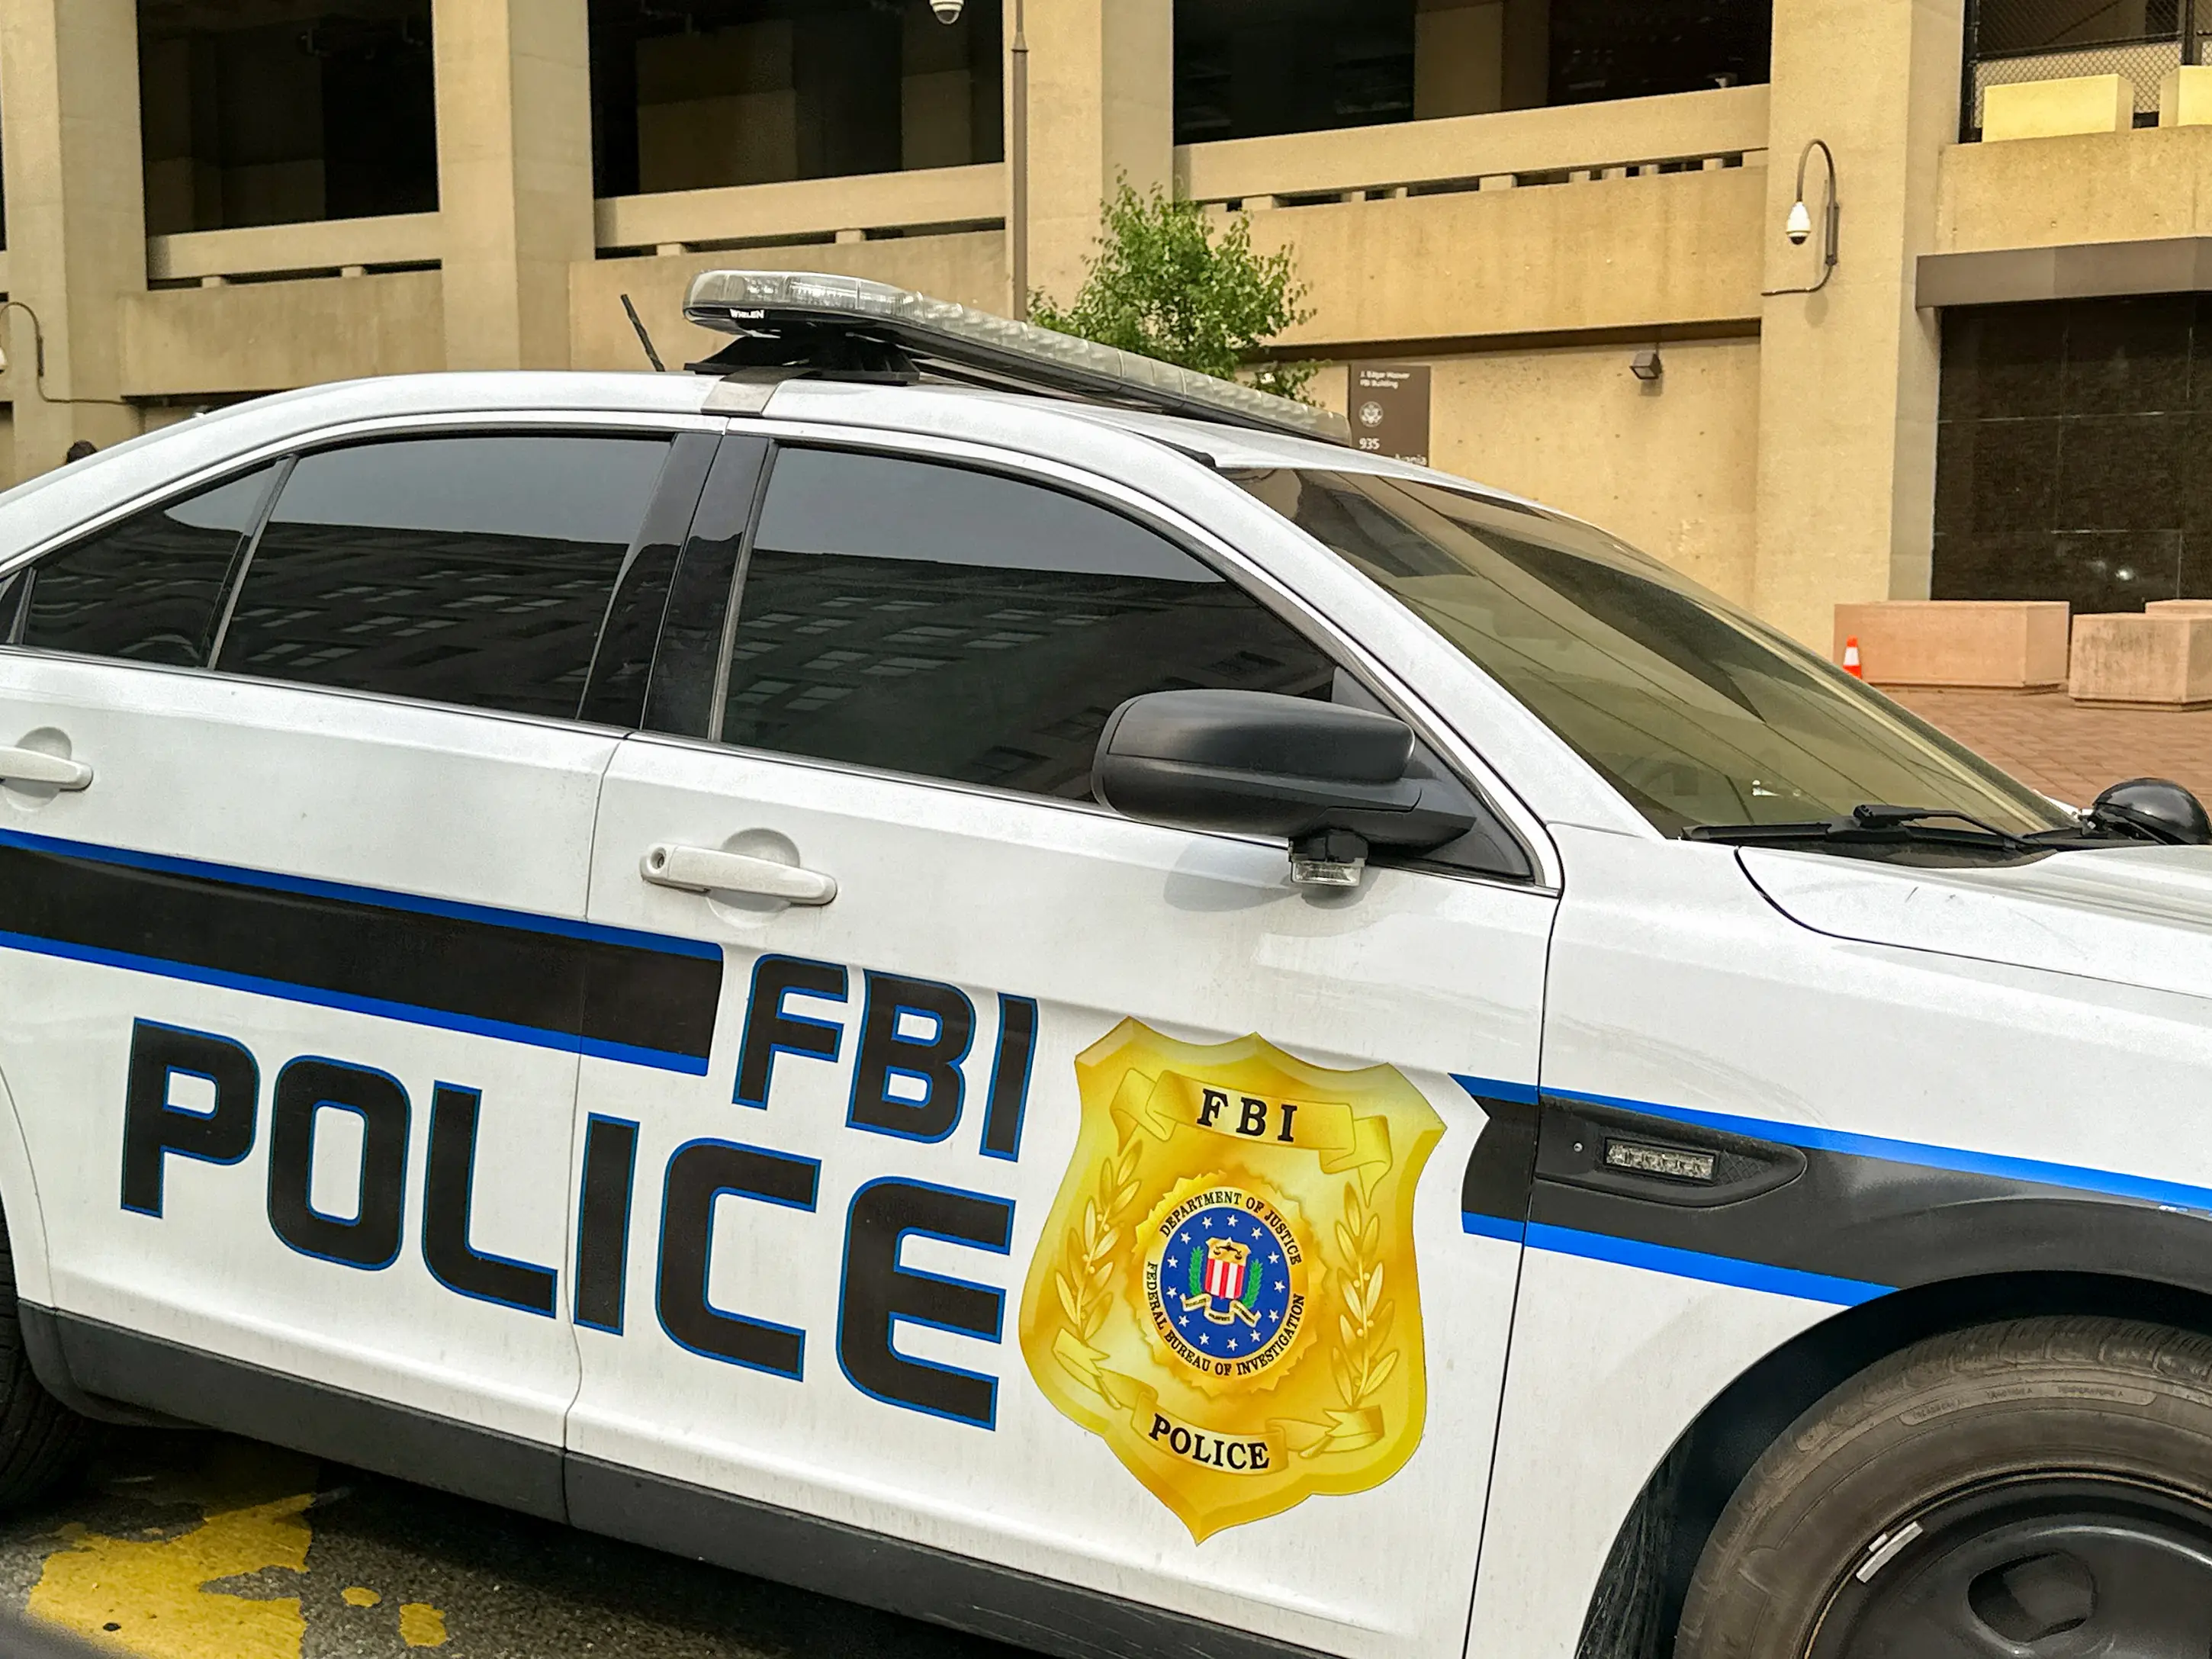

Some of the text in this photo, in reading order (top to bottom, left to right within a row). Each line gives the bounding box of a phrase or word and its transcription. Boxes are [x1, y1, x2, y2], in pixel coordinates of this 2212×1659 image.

[1358, 438, 1380, 450] 935
[731, 953, 1037, 1162] FBI
[1196, 1088, 1297, 1143] FBI
[121, 1017, 1016, 1431] POLICE
[1159, 1191, 1302, 1265] DEPARTMENT OF JUSTICE
[1147, 1262, 1305, 1376] FEDERAL BUREAU OF INVESTIGATION
[1148, 1413, 1270, 1470] POLICE
